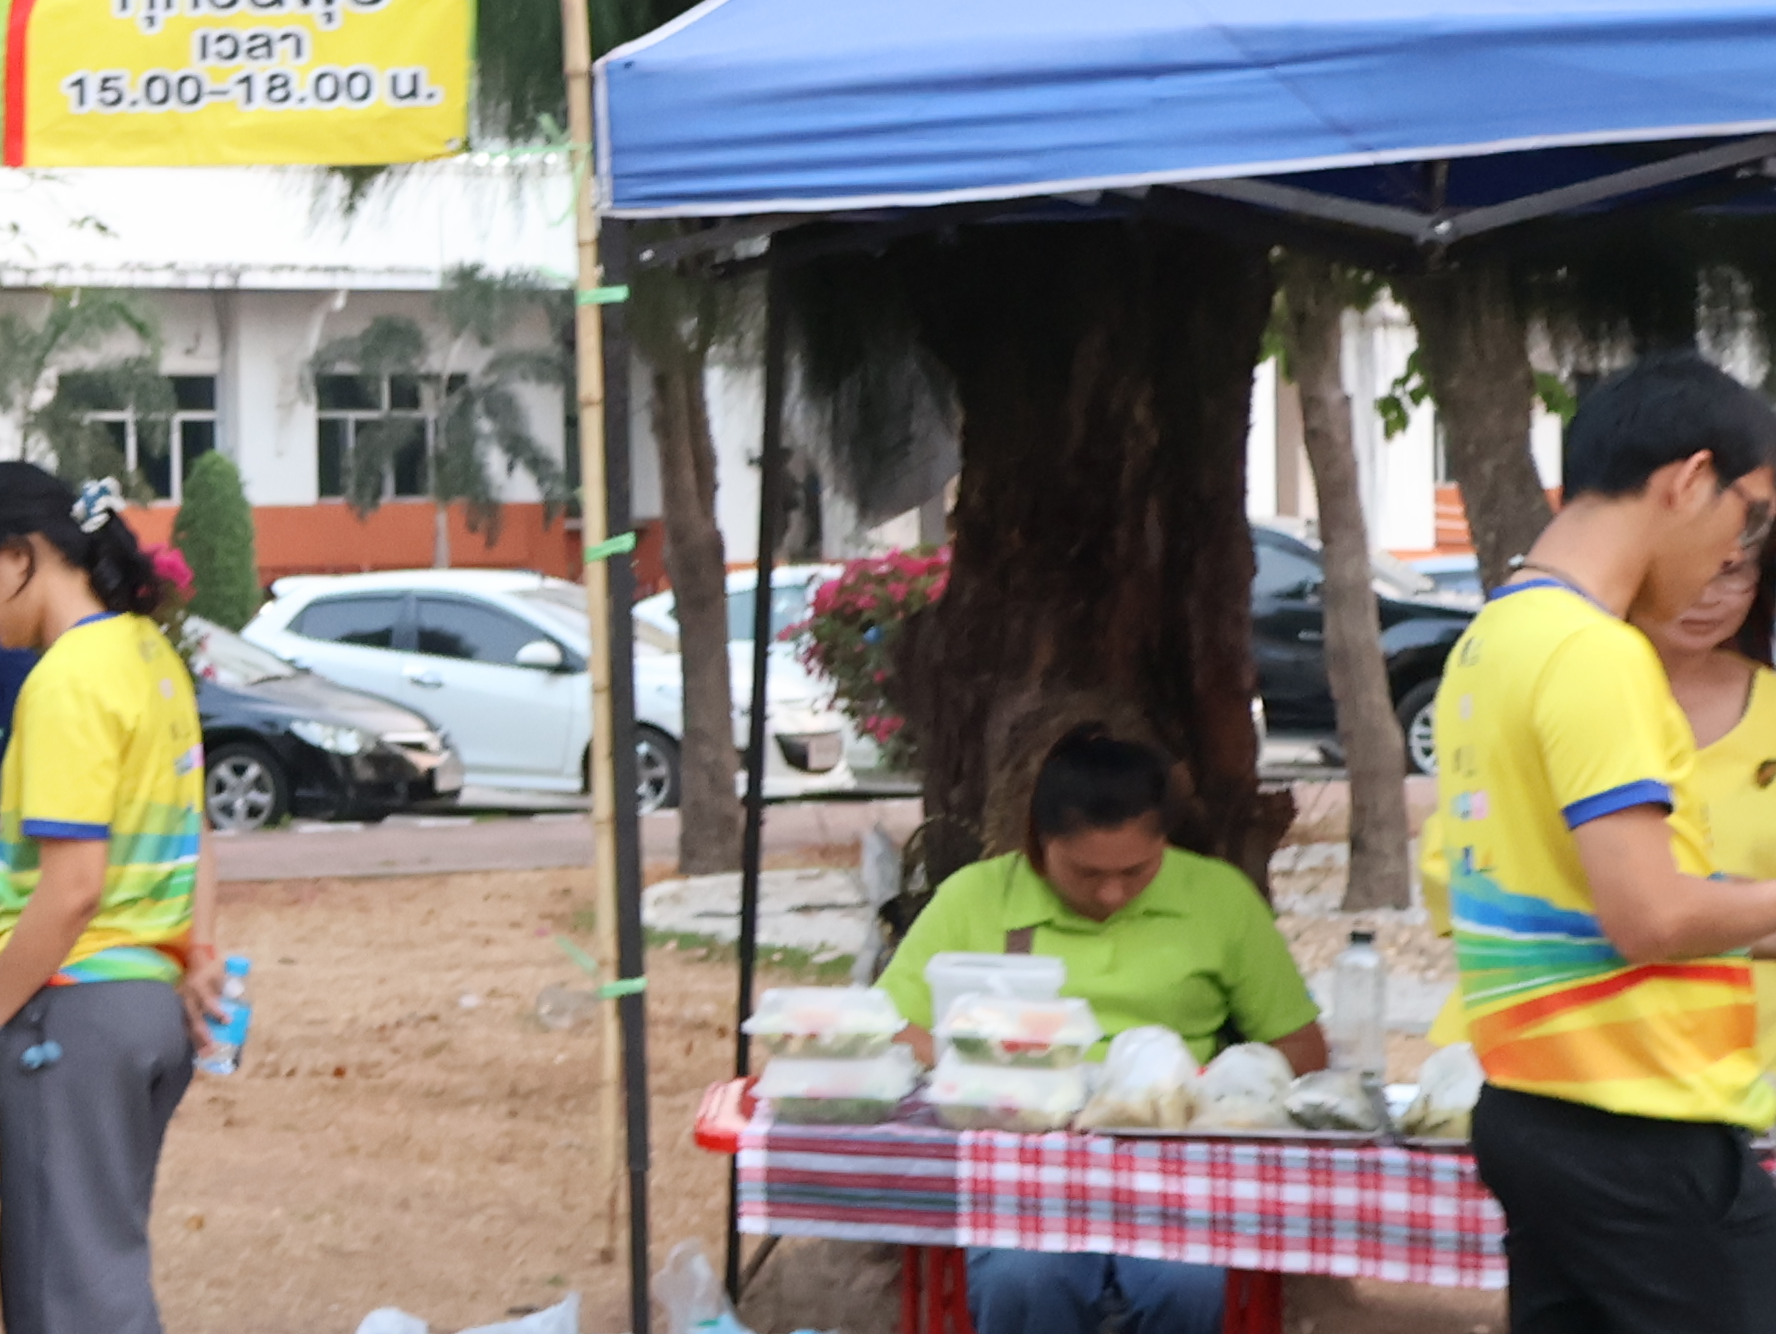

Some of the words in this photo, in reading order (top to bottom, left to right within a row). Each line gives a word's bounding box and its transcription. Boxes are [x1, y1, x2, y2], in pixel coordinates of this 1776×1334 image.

[198, 32, 303, 61] เวลา
[67, 70, 372, 108] 15.00-18.00
[390, 70, 437, 101] น.
